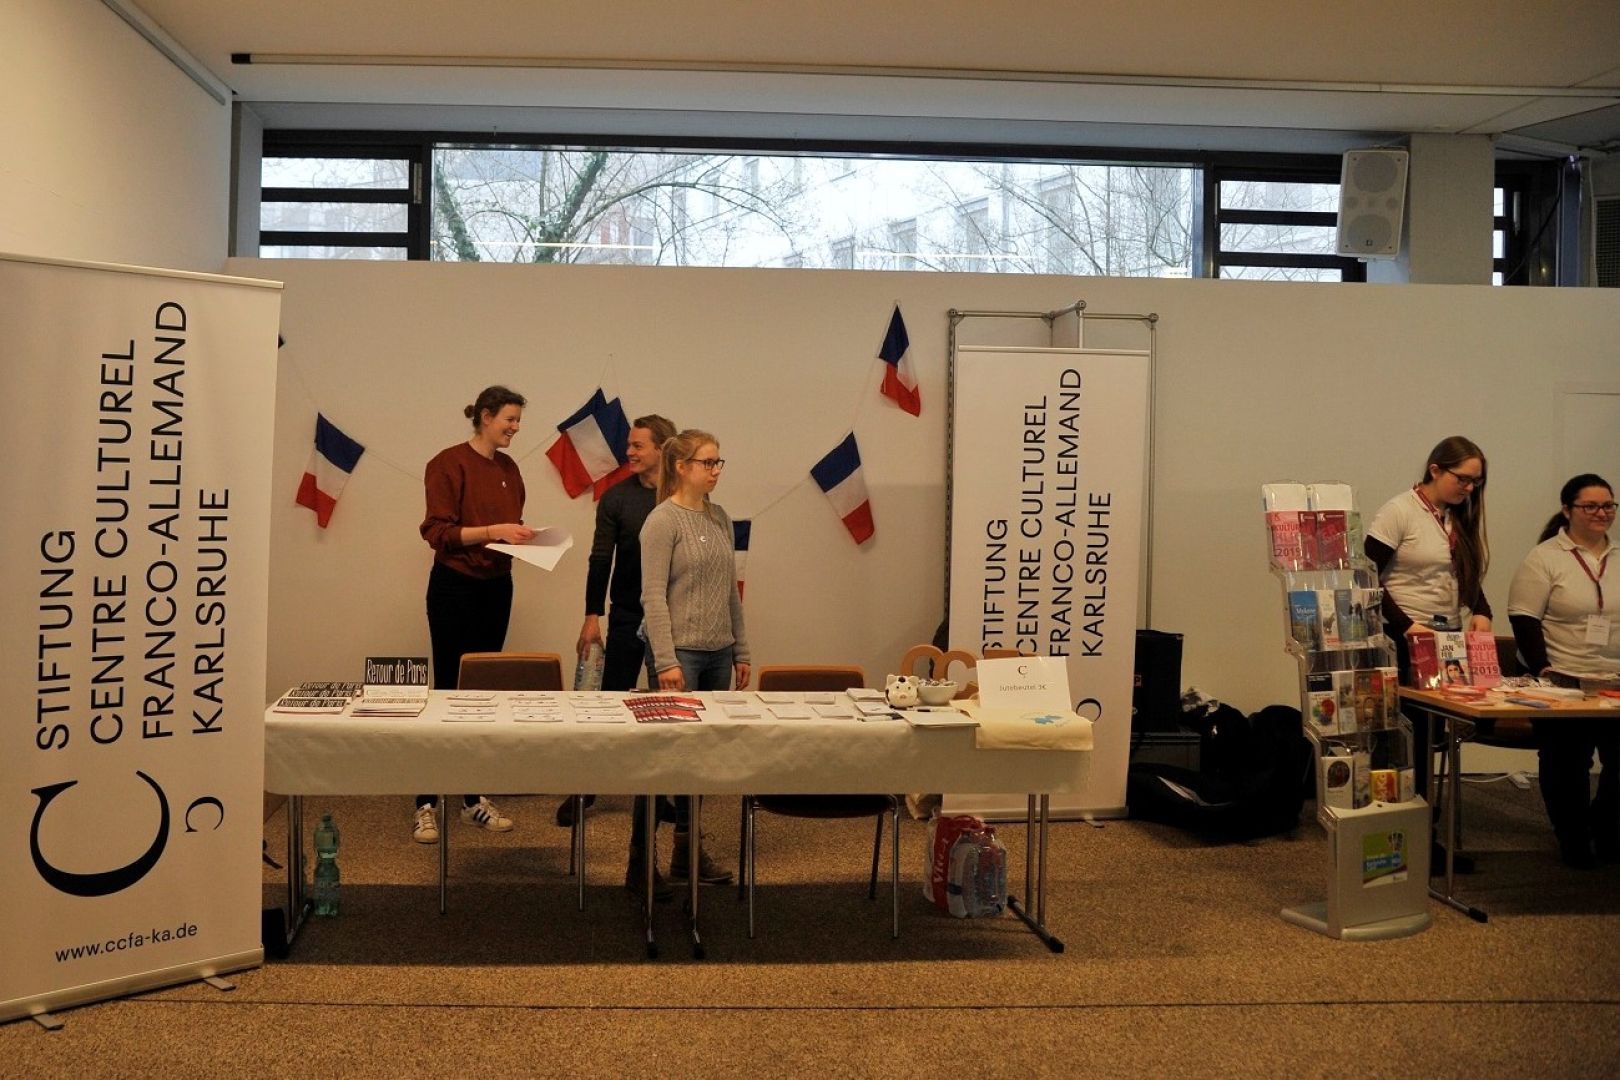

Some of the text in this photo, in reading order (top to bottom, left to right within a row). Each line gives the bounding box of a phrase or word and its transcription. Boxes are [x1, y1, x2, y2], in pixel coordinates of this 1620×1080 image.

[90, 339, 135, 744] CENTRE CULTUREL
[143, 301, 186, 739] FRANCO-ALLEMAND
[192, 488, 229, 734] KARLSRUHE
[1016, 395, 1047, 656] CENTRE CULTUREL
[1050, 368, 1081, 657] FRANCO-ALLEMAND
[1082, 492, 1111, 657] KARLSRUHE
[36, 530, 75, 750] STIFTUNG
[367, 659, 427, 684] Retour de Paris
[55, 923, 198, 963] www.ccfa-ka.de
